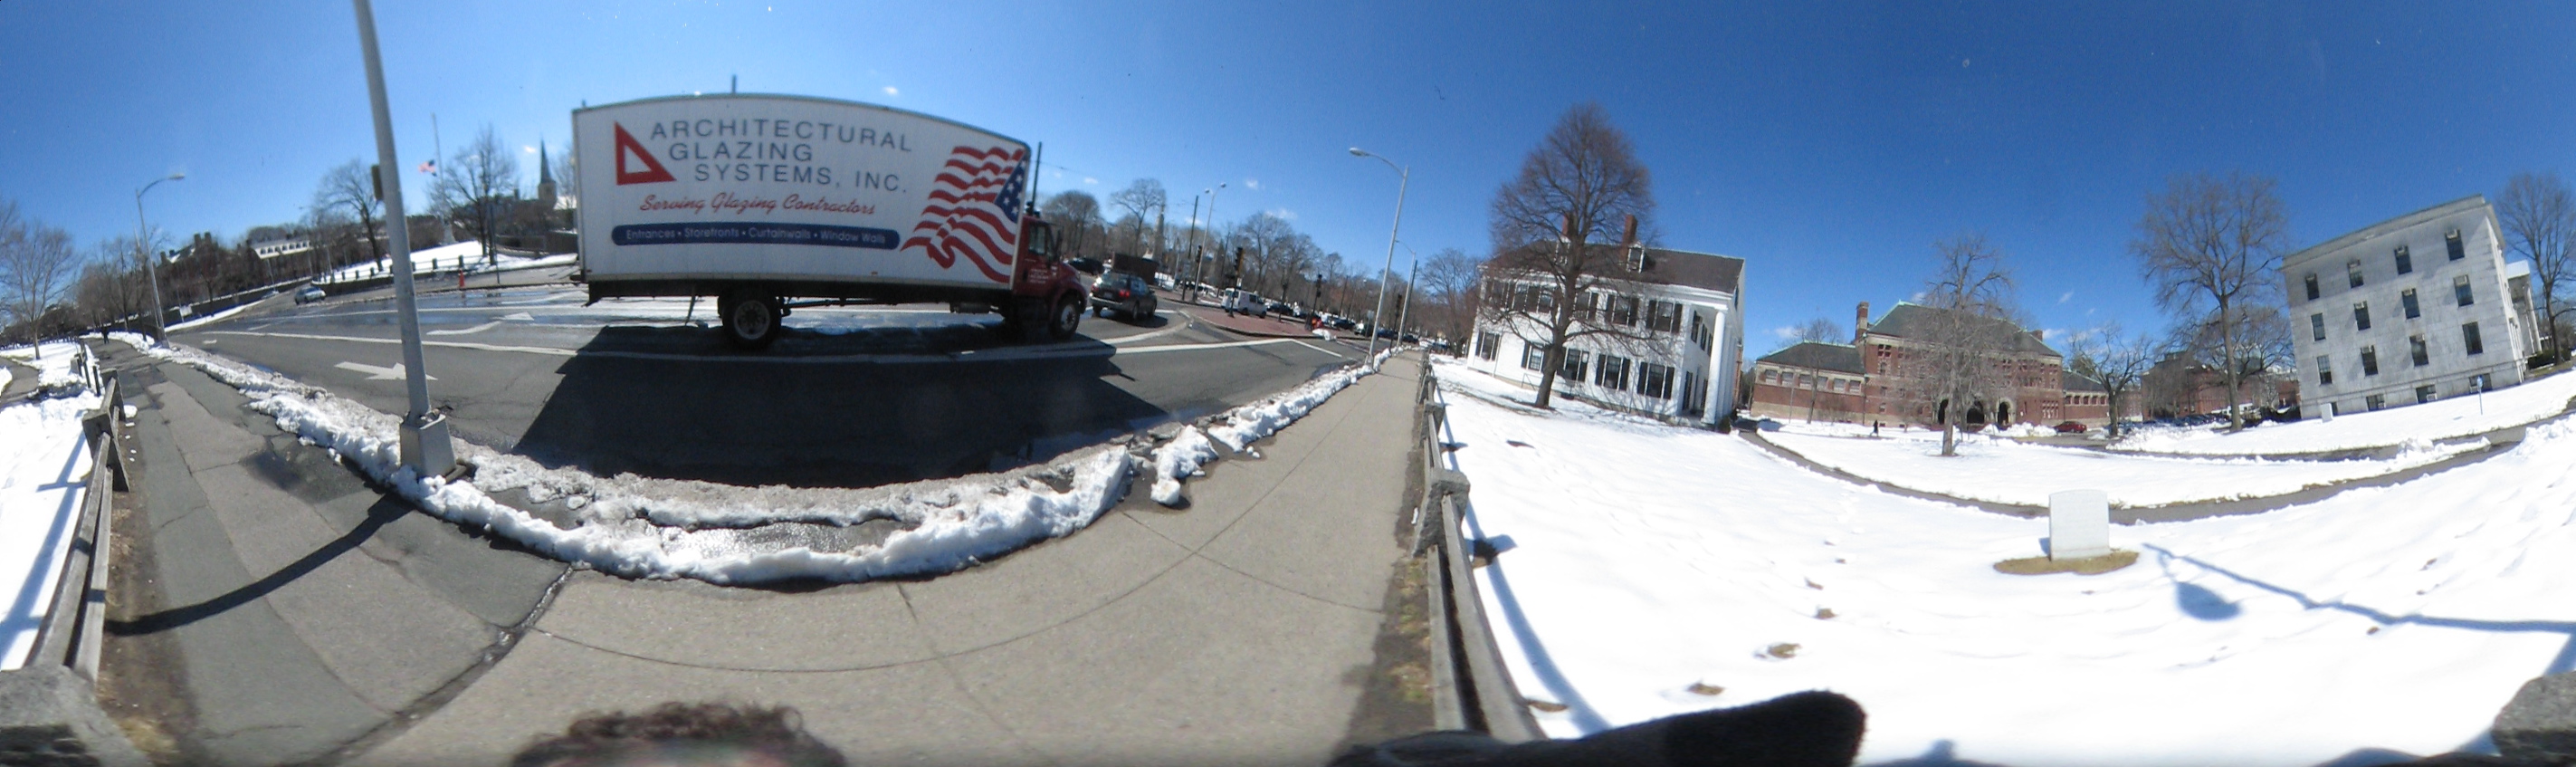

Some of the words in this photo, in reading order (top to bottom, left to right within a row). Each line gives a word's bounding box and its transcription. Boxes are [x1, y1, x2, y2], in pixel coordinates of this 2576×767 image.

[650, 119, 911, 152] ARCHITECTURAL
[669, 141, 813, 162] GLAZING
[694, 163, 840, 188] SYSTEMS,
[855, 170, 906, 193] INC.
[639, 194, 706, 215] Serving
[711, 191, 777, 215] Glazing
[782, 193, 875, 215] Contractors
[626, 229, 675, 240] Entrances
[684, 227, 739, 238] Storefronts
[749, 227, 811, 239] Curtainwalls
[820, 230, 859, 241] Window
[862, 233, 886, 244] Walls
